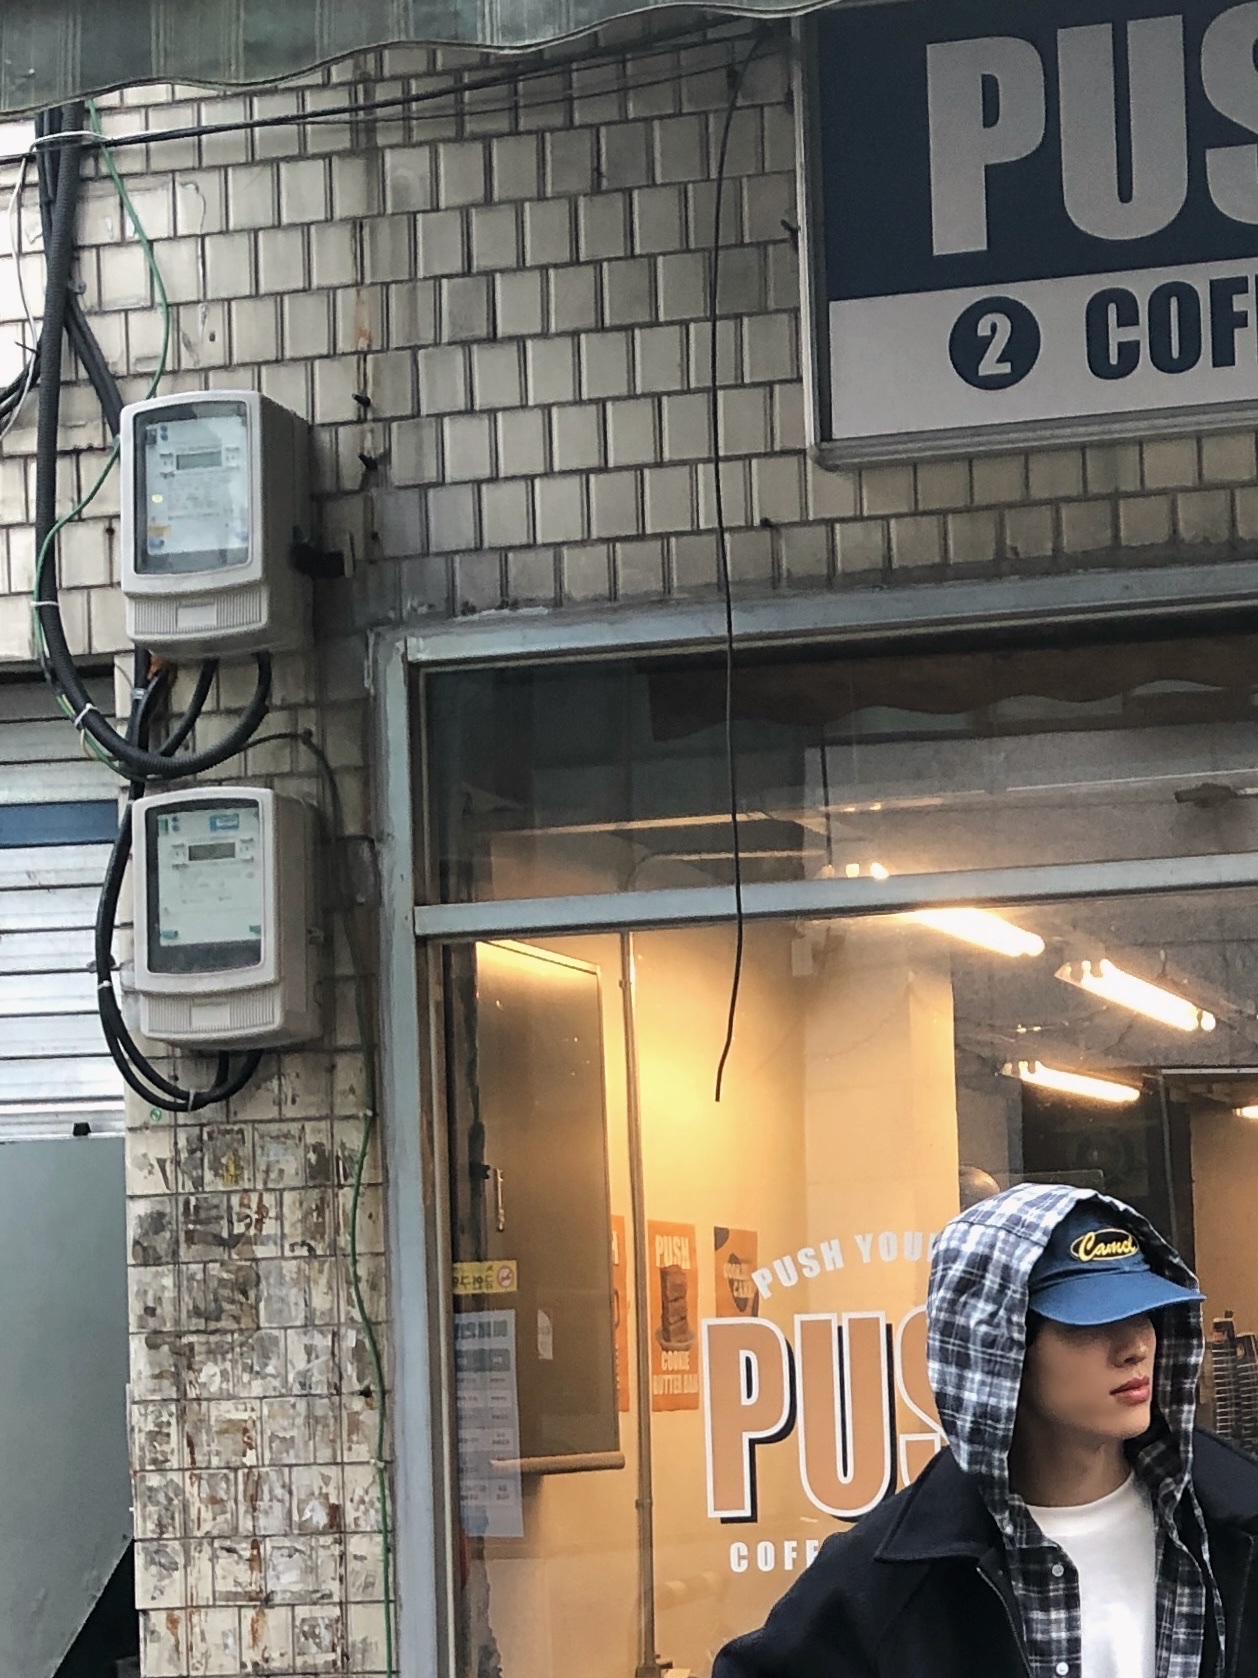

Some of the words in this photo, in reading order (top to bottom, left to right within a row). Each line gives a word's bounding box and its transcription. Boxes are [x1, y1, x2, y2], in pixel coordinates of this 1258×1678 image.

[655, 1234, 691, 1269] PUSH
[751, 1238, 845, 1300] PUSH
[701, 1305, 950, 1524] PUS
[730, 1540, 819, 1573] COFF
